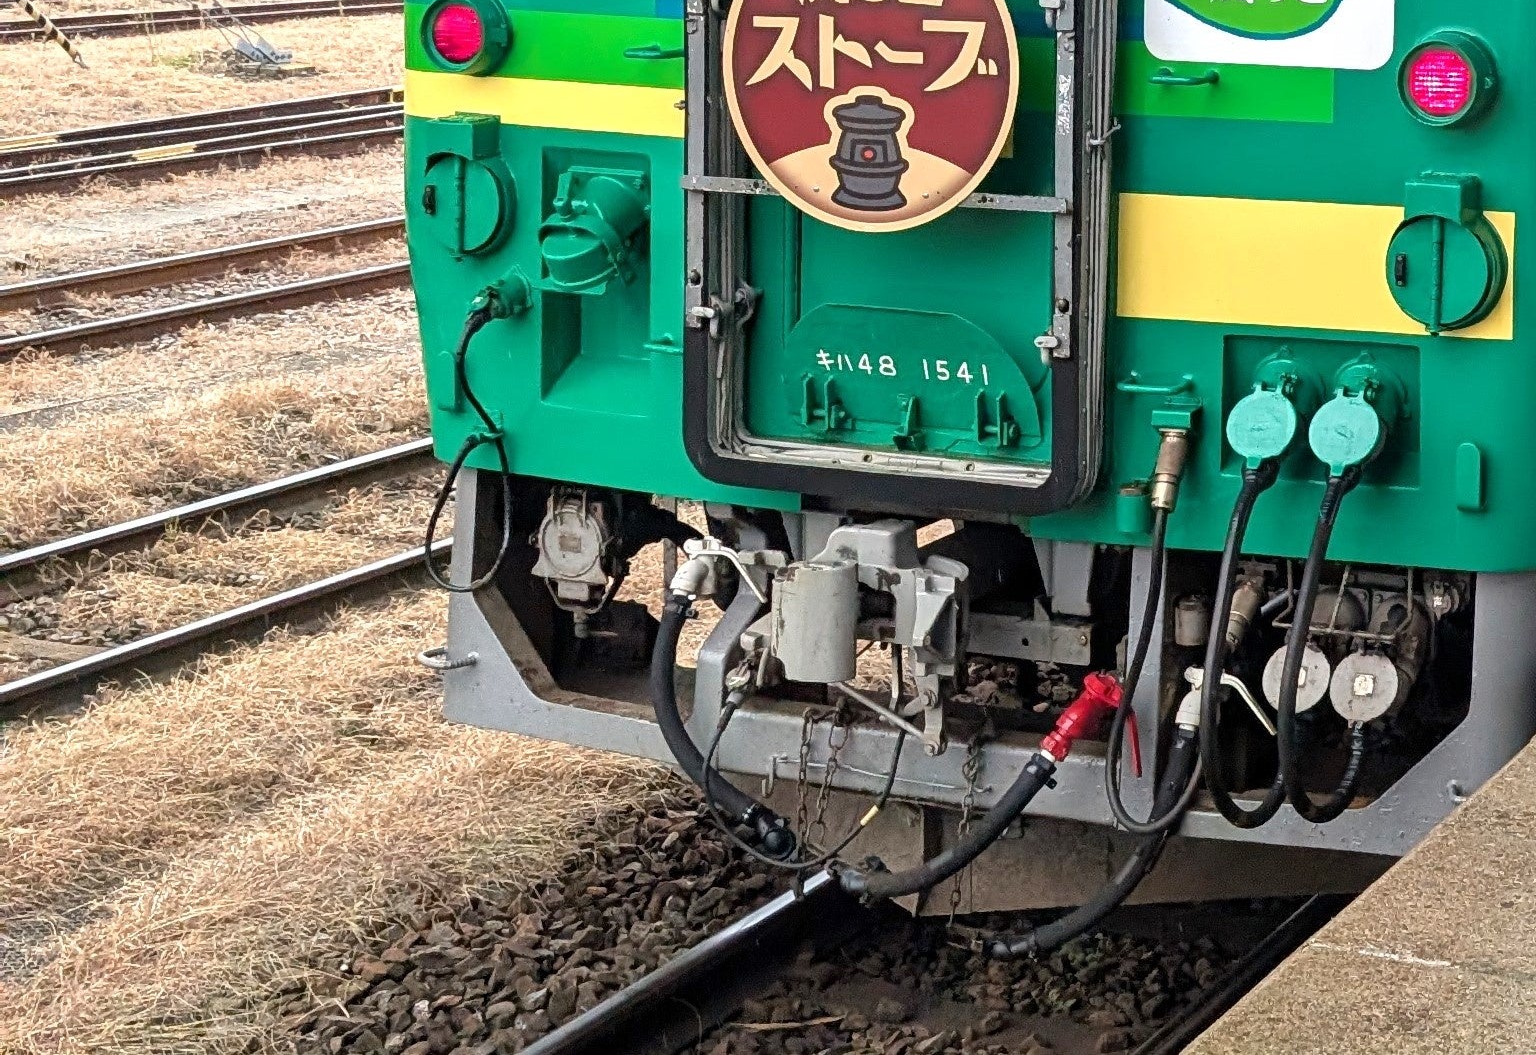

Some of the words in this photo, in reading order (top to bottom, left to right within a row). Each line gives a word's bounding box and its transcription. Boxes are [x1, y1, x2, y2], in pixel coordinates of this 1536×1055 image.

[745, 13, 999, 93] ストーブ
[816, 348, 897, 377] キハ48
[922, 358, 989, 386] 1541
